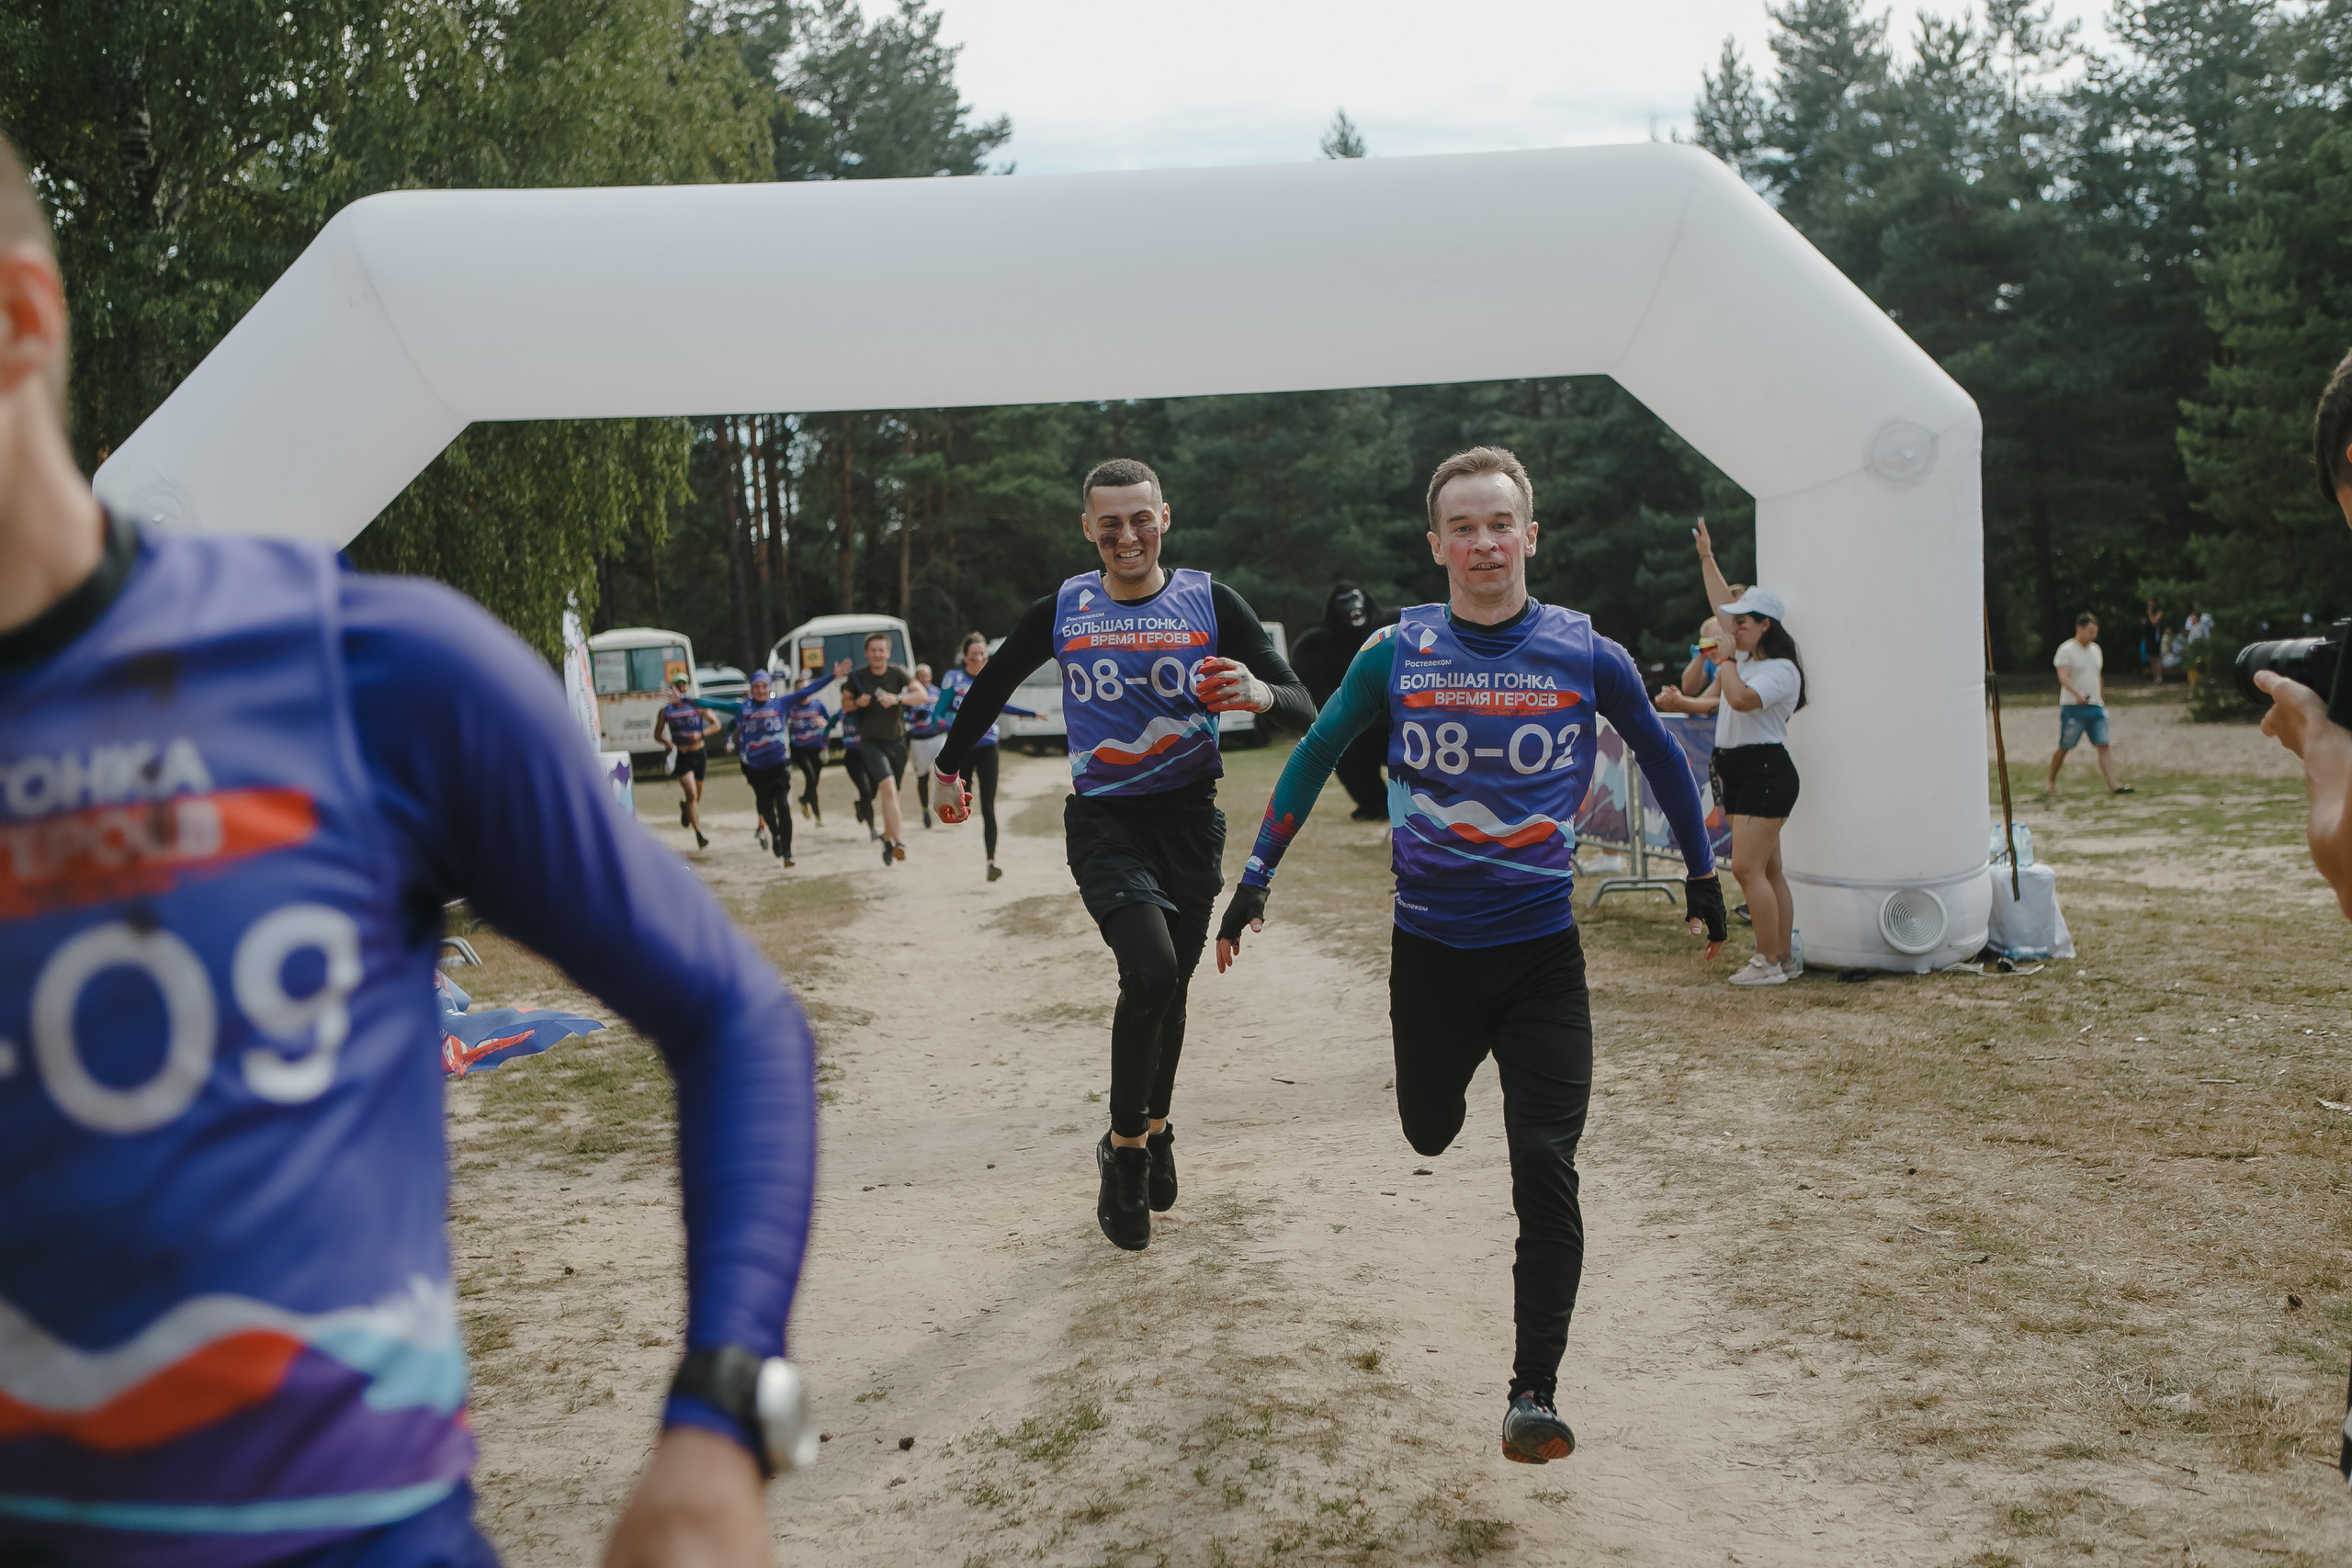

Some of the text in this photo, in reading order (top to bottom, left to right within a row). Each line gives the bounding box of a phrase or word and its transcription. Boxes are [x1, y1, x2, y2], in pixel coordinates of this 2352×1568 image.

[1066, 612, 1105, 623] Ростелеком
[1061, 617, 1190, 637] БОЛЬШАЯ ГОНКА
[1090, 632, 1192, 647] ВРЕМЯ ГЕРОЕВ
[1405, 659, 1453, 668] Ростелеком
[1400, 673, 1558, 689] БОЛЬШАЯ ГОНКА
[1434, 691, 1558, 706] ВРЕМЯ ГЕРОЕВ
[1402, 721, 1580, 775] 08-02
[0, 795, 226, 880] ЕРОЕВ
[0, 903, 362, 1131] 09
